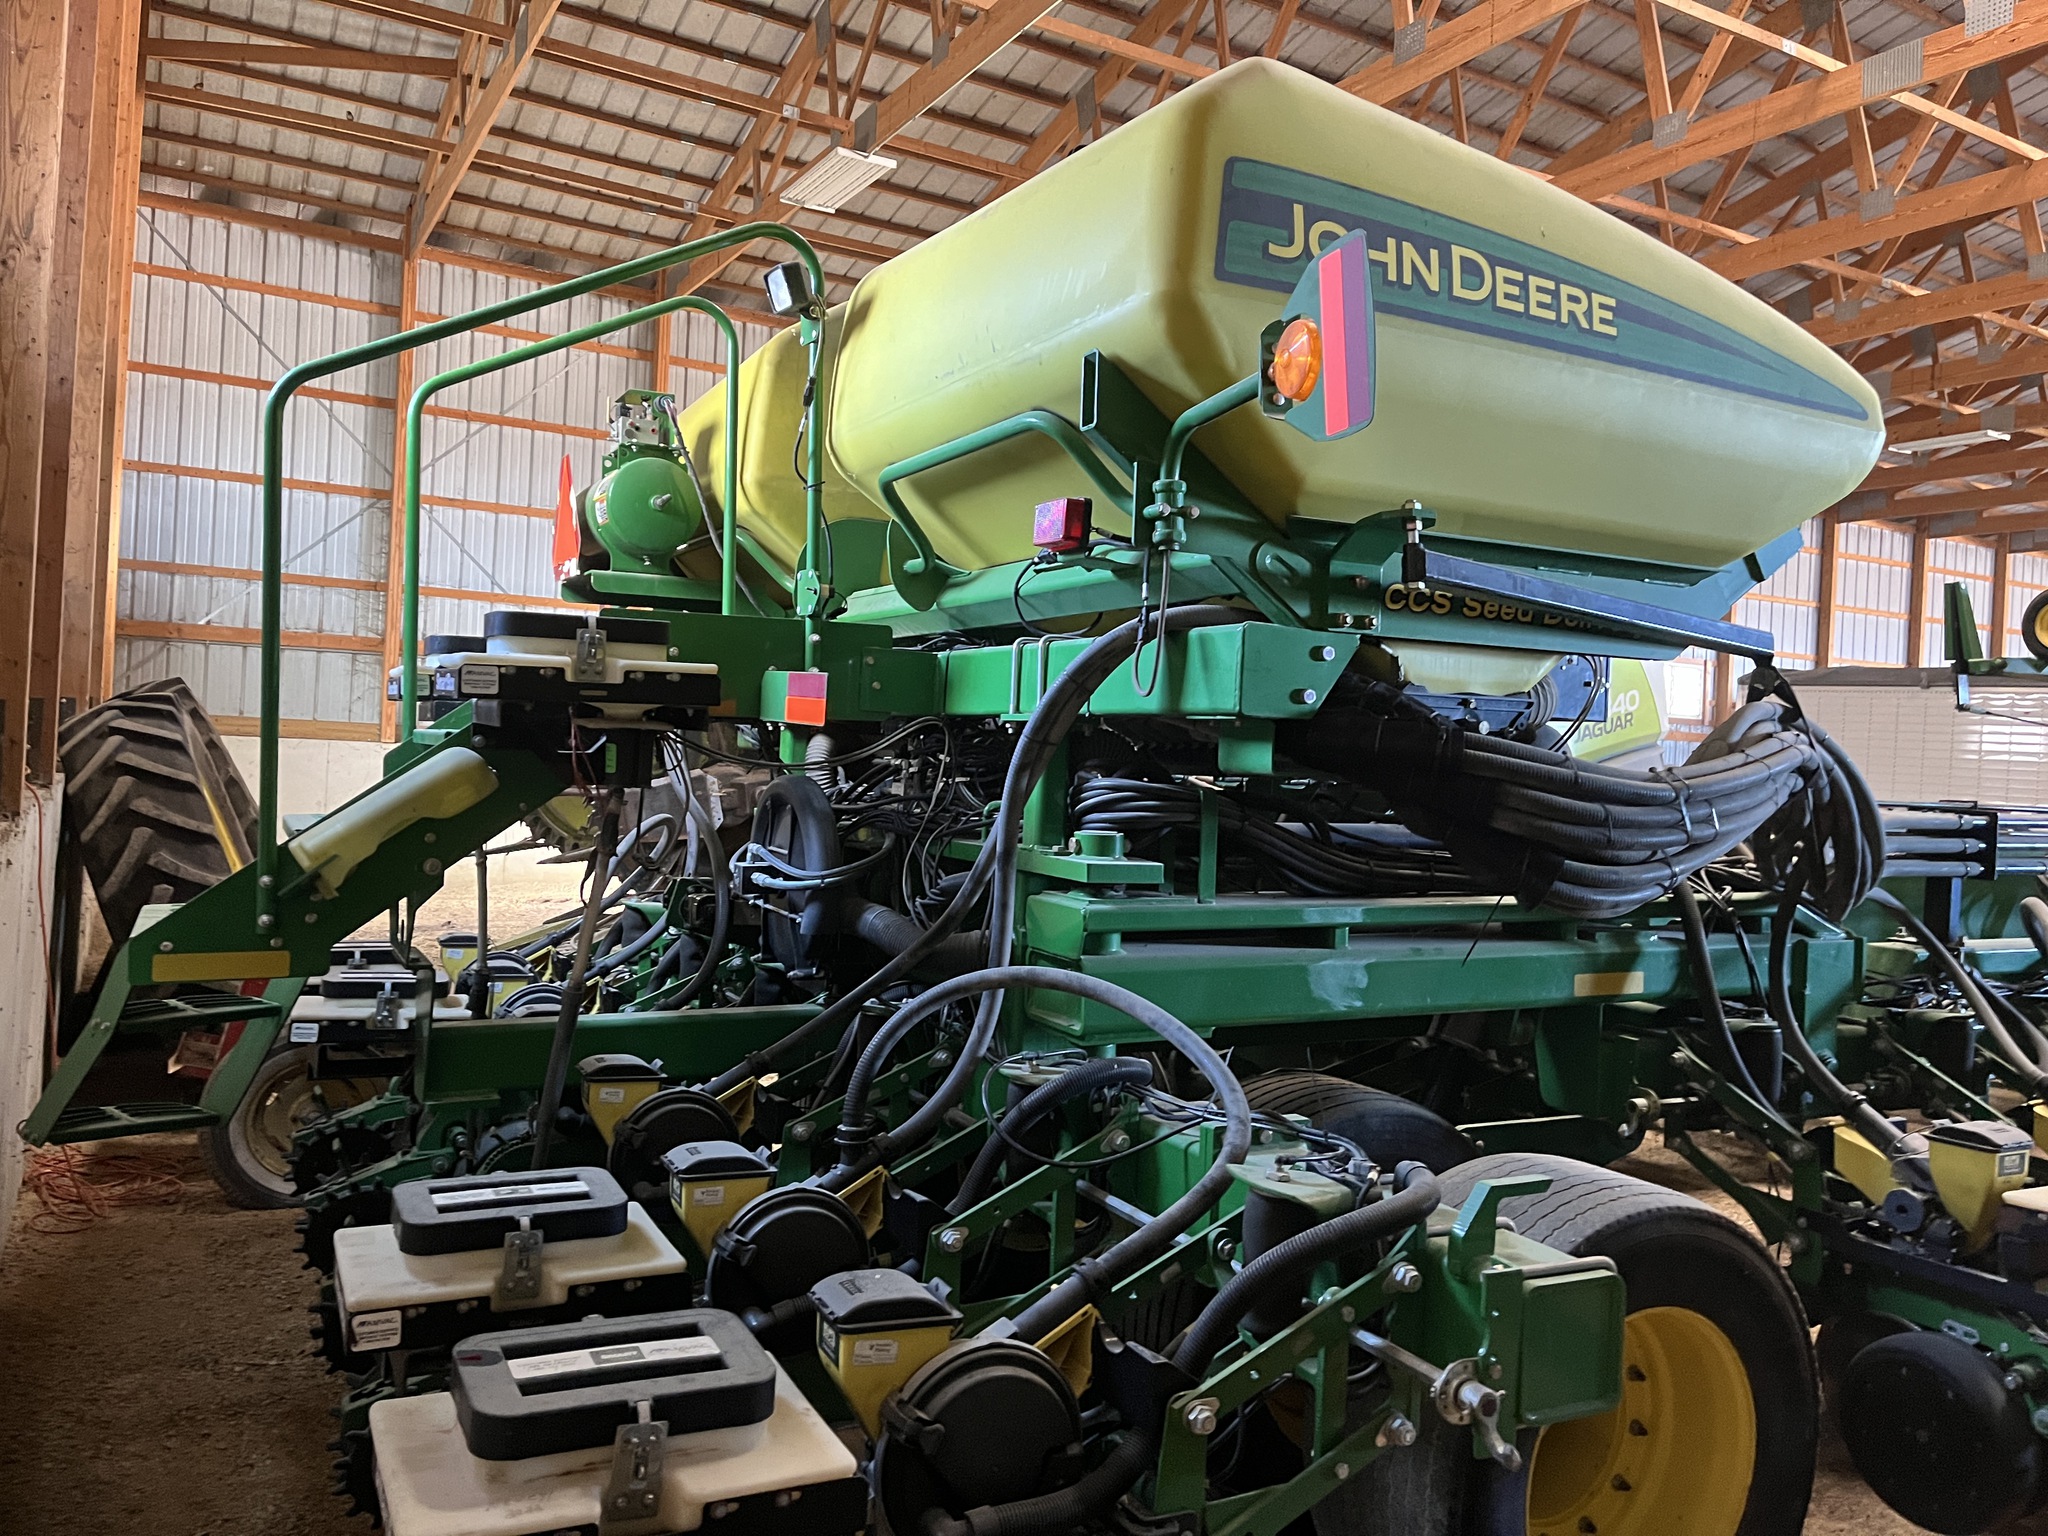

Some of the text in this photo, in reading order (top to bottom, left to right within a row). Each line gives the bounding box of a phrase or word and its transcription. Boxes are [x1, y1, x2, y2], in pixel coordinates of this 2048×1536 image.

[1267, 203, 1619, 337] JOHN DEERE
[1384, 583, 1453, 615] CCS
[1574, 712, 1634, 744] JAGUAR
